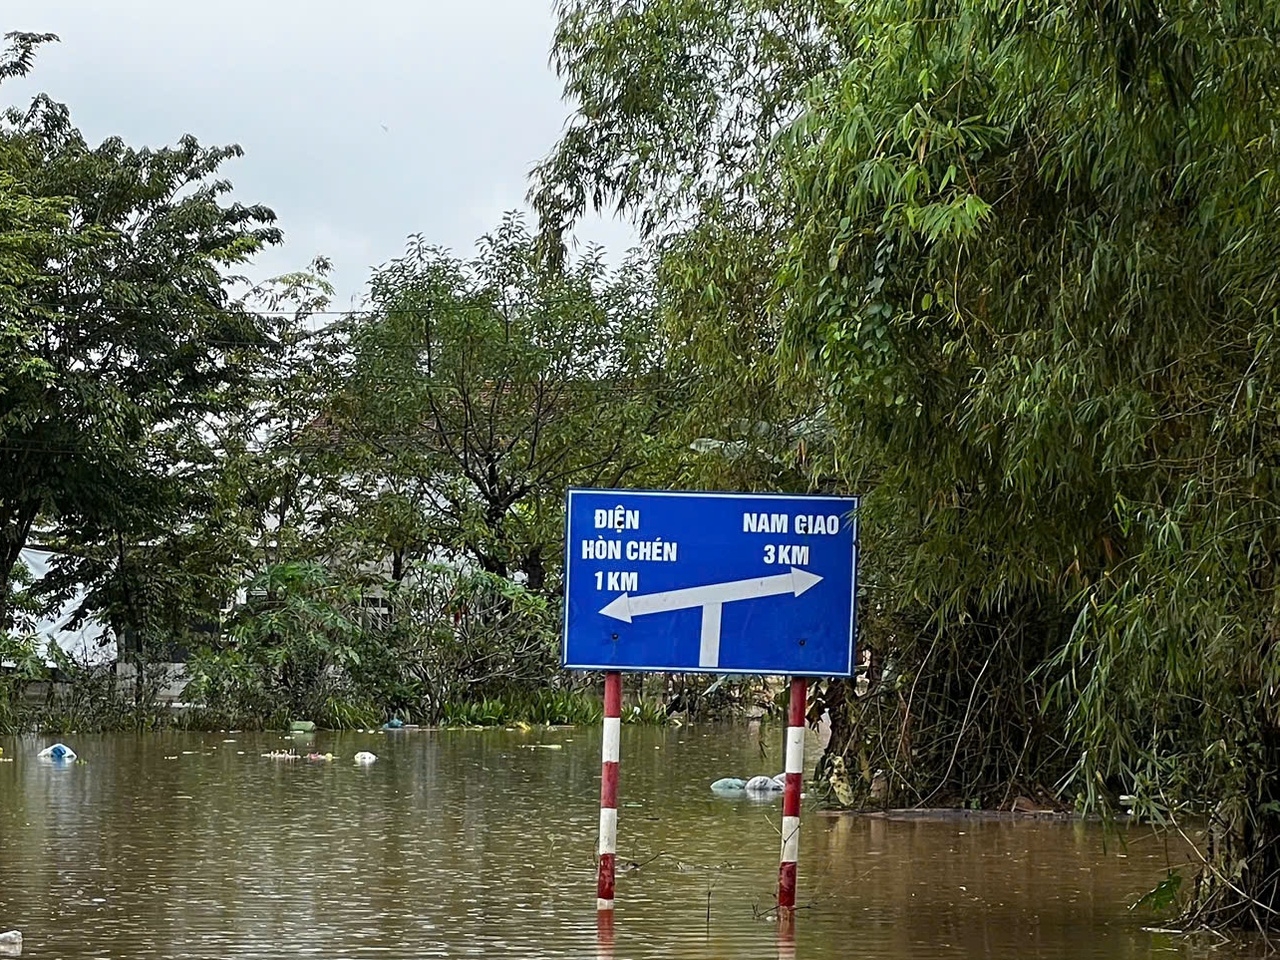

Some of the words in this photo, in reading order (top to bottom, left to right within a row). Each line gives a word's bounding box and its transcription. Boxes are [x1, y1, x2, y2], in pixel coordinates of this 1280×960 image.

[594, 505, 639, 533] ĐIỆN
[743, 512, 788, 533] NAM
[794, 514, 839, 535] GIAO
[581, 535, 622, 560] HÒN
[626, 537, 677, 562] CHÉN
[763, 544, 776, 564] 3
[778, 544, 809, 565] KM
[594, 571, 603, 590] 1
[607, 571, 638, 591] KM
